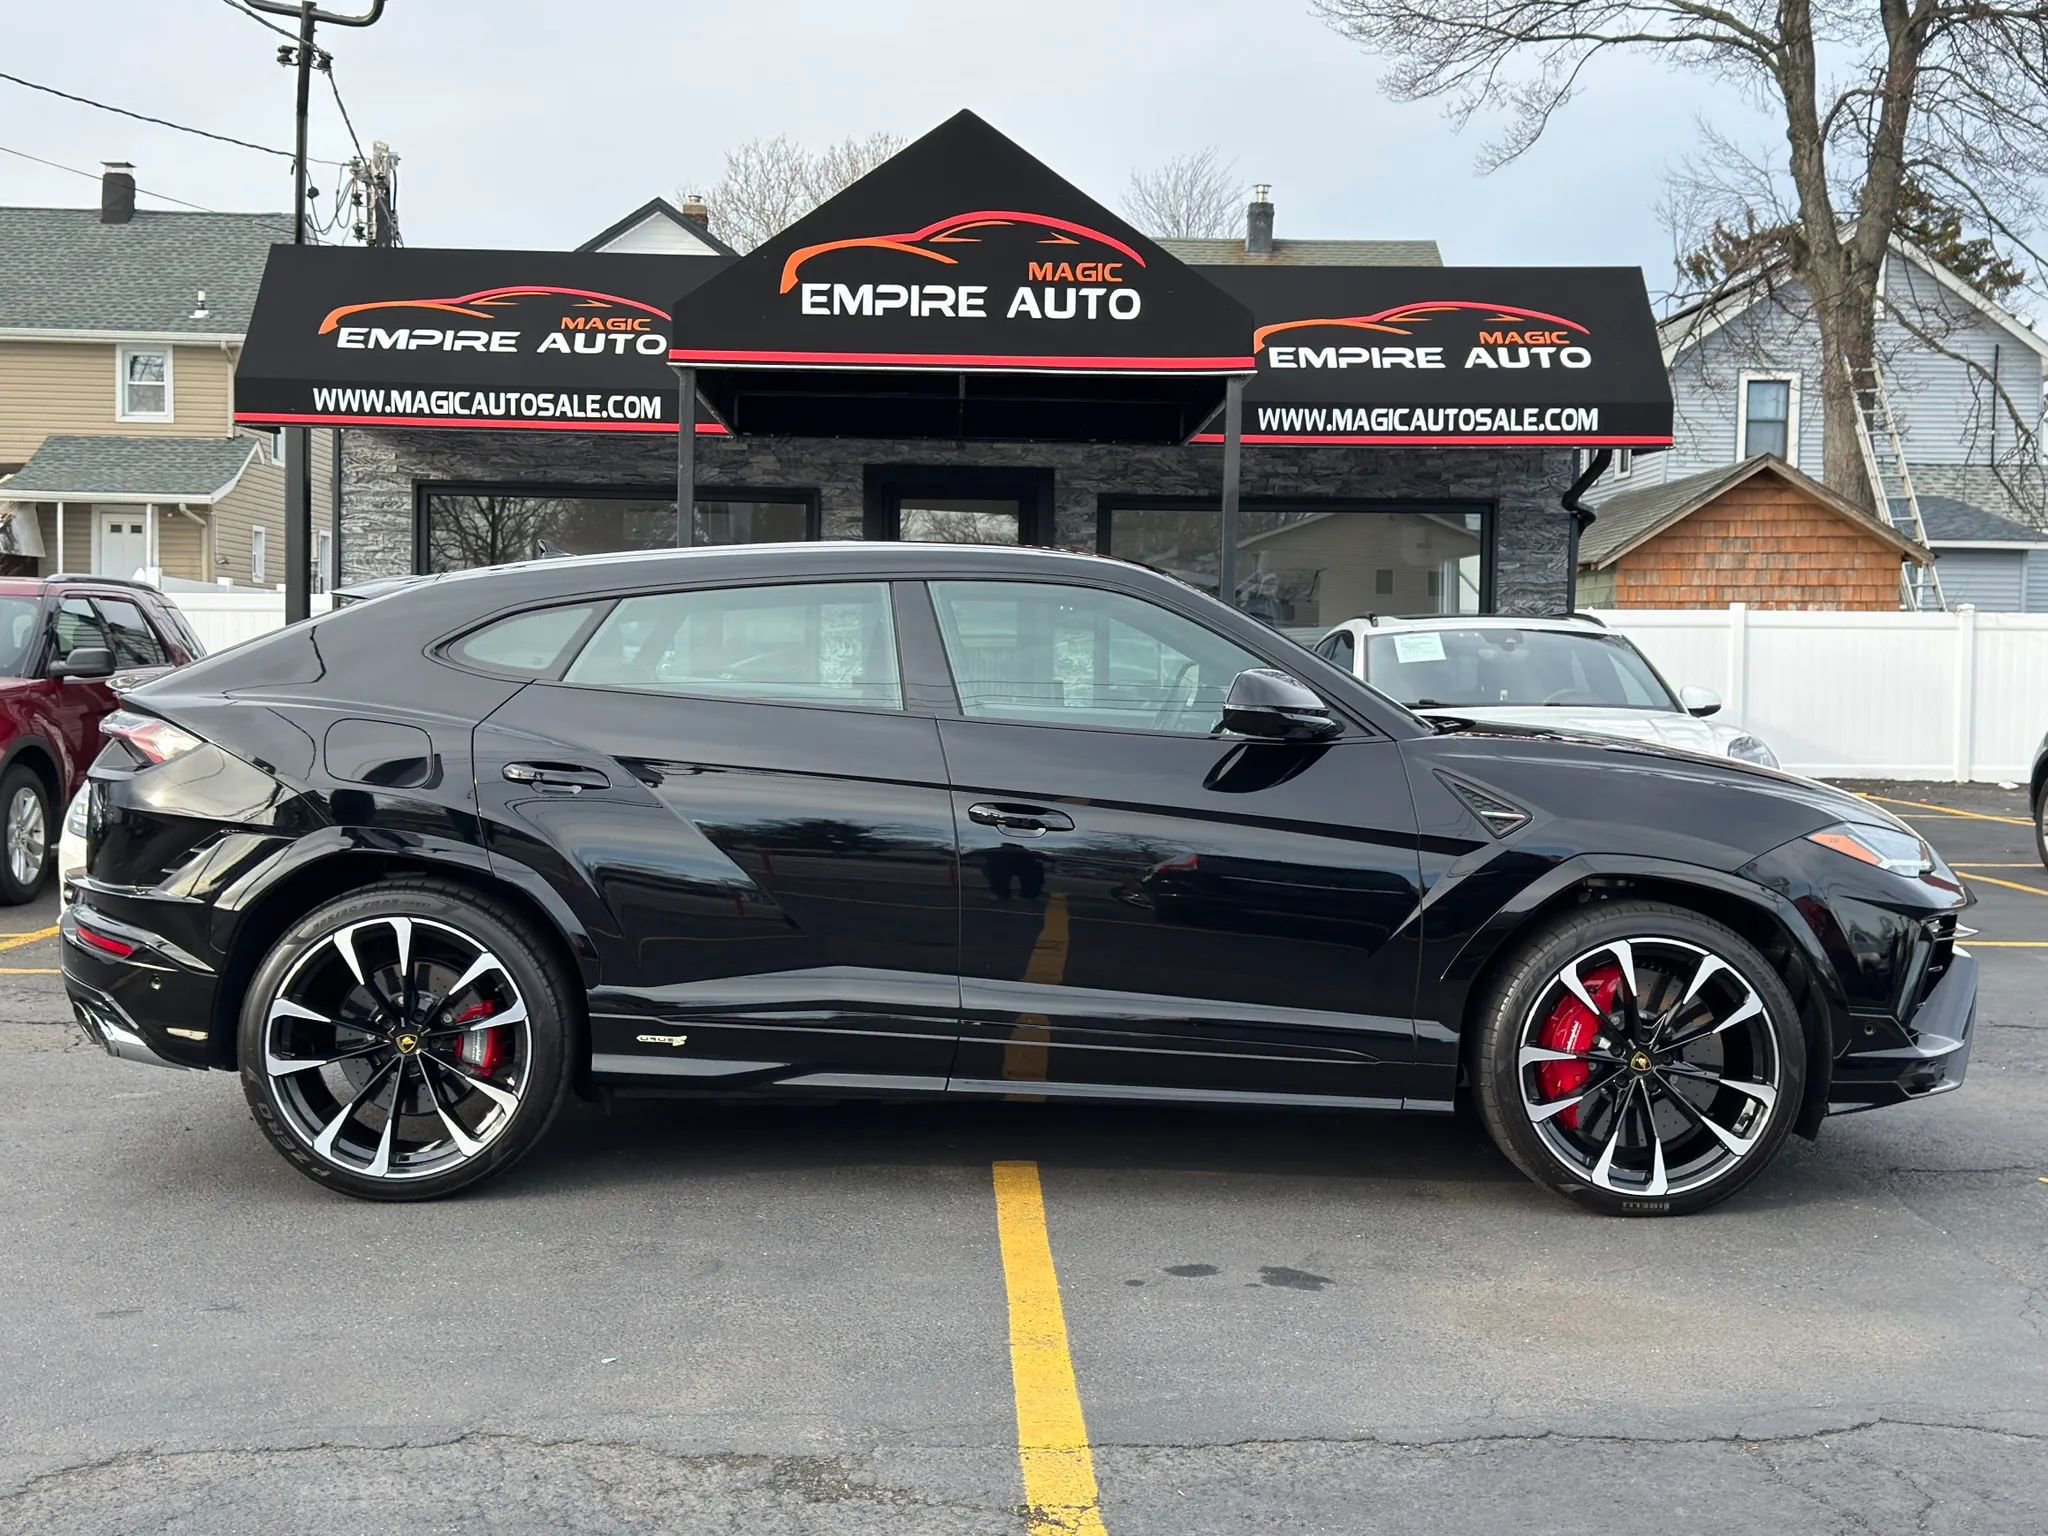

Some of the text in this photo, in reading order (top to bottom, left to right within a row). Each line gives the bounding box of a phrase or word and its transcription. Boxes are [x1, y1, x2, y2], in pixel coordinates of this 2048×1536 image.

[1028, 262, 1123, 282] MAGIC
[801, 283, 1142, 320] EMPIRE AUTO
[560, 315, 652, 332] MAGIC
[336, 326, 668, 356] EMPIRE AUTO
[1478, 330, 1570, 345] MAGIC
[1268, 346, 1592, 369] EMPIRE AUTO
[312, 387, 662, 420] WWW.MAGICAUTOSALE.COM
[1257, 407, 1599, 432] WWW.MAGICAUTOSALE.COM
